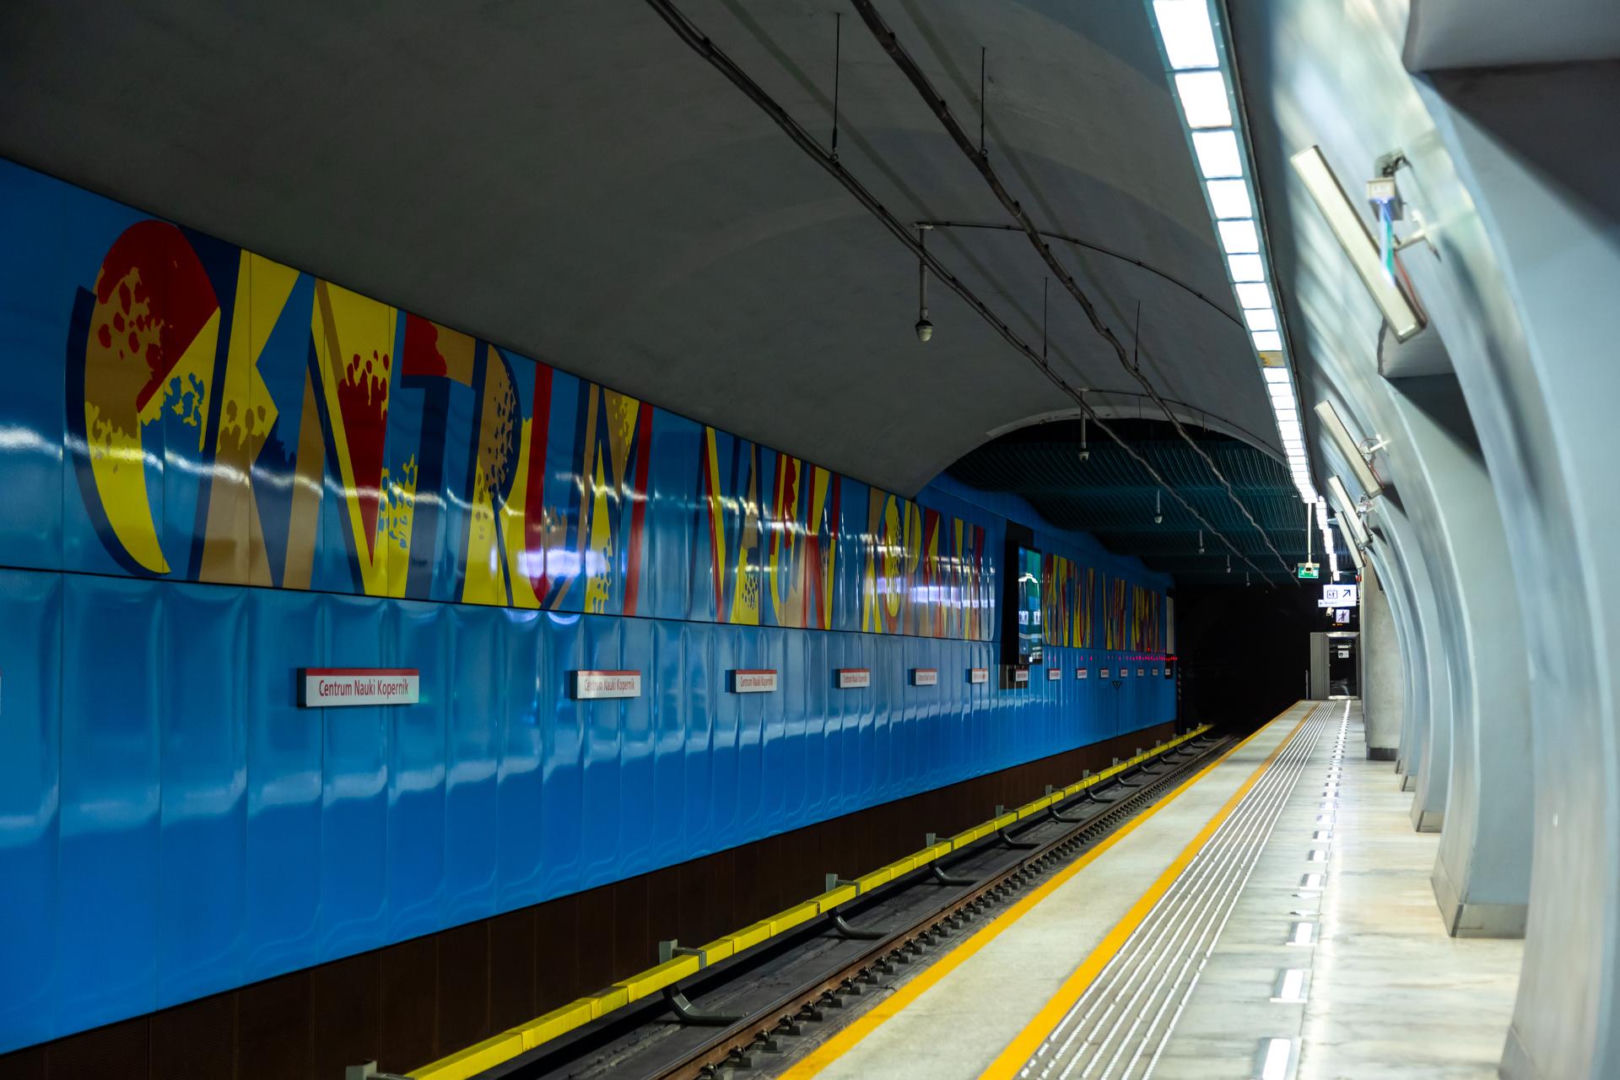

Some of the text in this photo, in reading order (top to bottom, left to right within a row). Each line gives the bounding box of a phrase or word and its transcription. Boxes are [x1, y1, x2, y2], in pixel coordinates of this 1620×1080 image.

[319, 678, 409, 699] Centrum Nauki Kopernik
